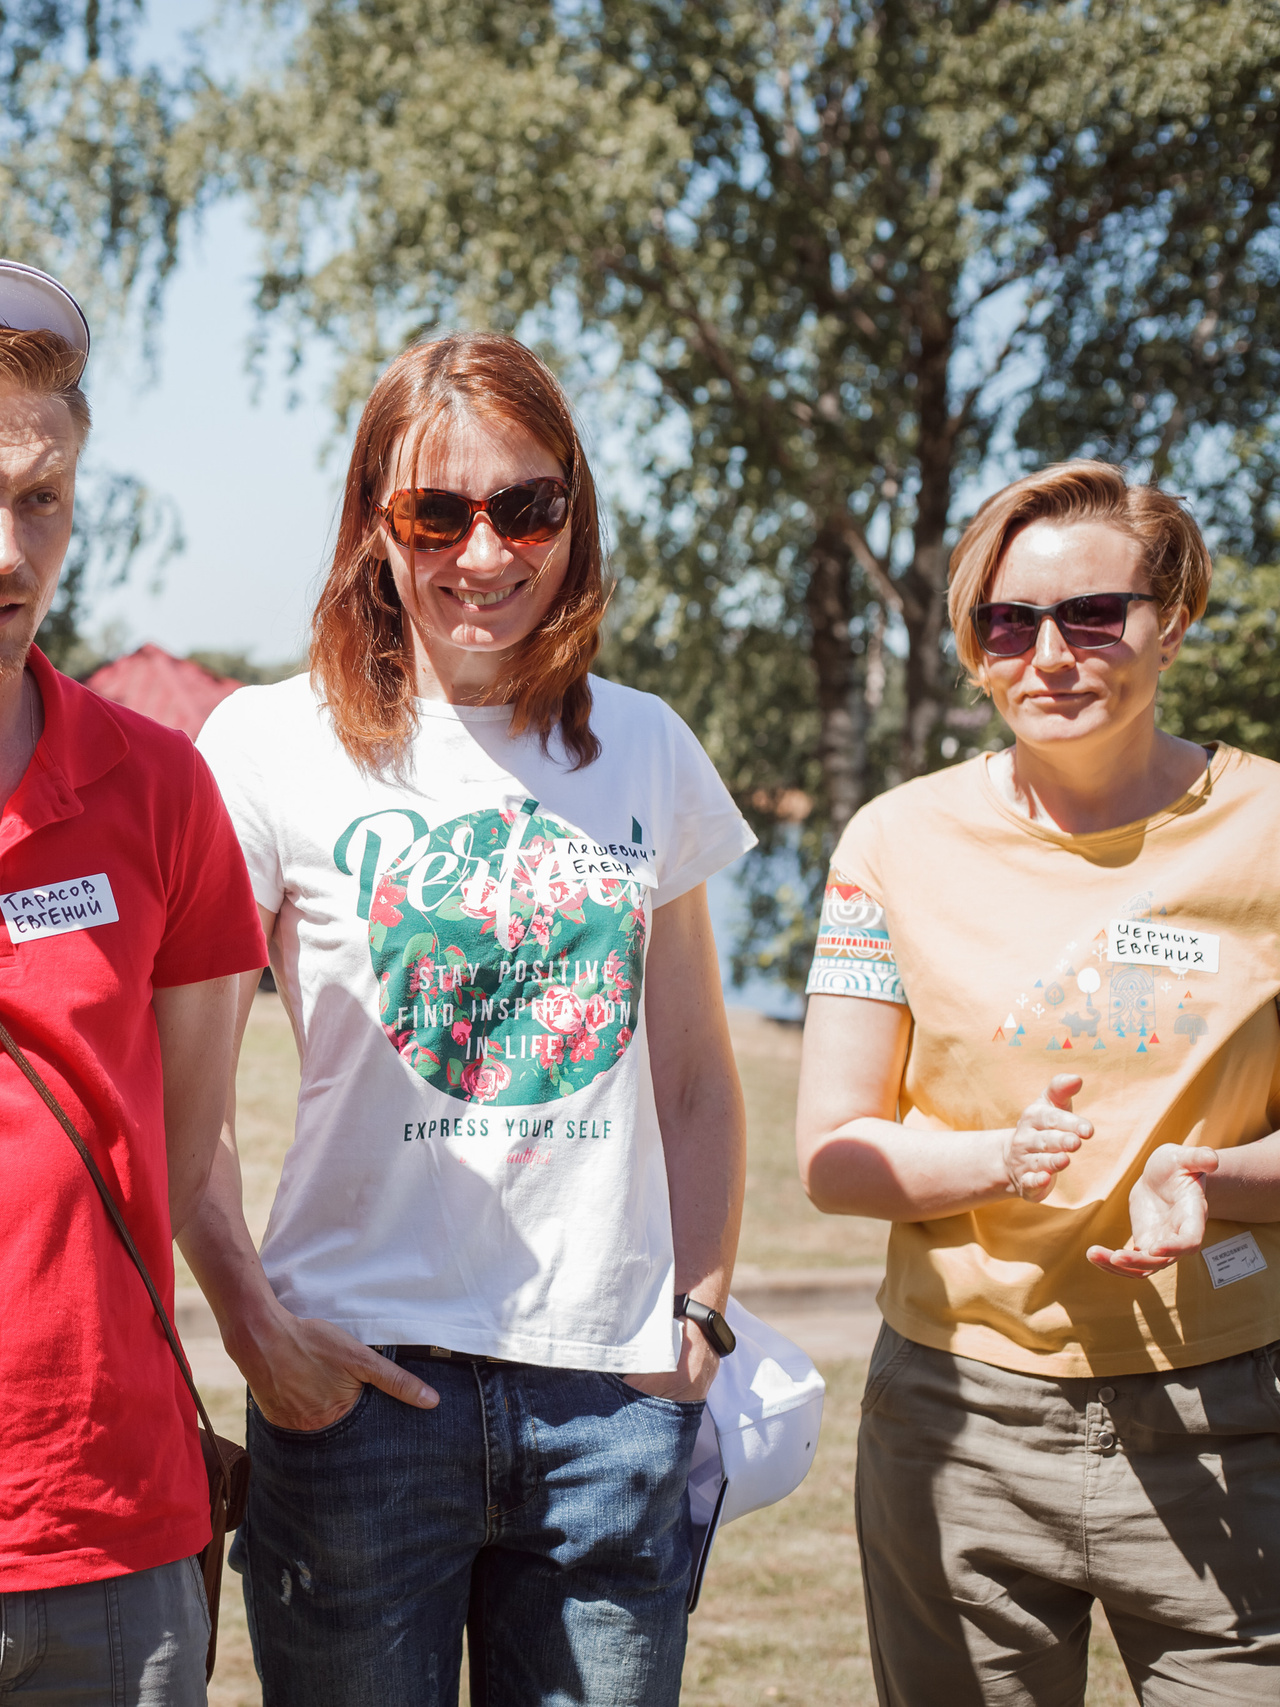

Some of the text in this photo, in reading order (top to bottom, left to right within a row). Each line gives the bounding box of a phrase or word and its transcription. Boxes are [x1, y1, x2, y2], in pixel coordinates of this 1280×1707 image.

[3, 880, 96, 911] ТАРАСОВ
[13, 896, 103, 933] ЕВГЕНИЙ
[1117, 924, 1199, 946] ЧЕРНЫХ
[1116, 939, 1205, 963] ЕВГЕНИЯ
[418, 960, 616, 990] STAY POSITIVE
[397, 997, 632, 1030] FIND INSPIRATION
[465, 1034, 560, 1060] IN LIFE
[403, 1118, 613, 1142] EXPRESS YOUR SELF
